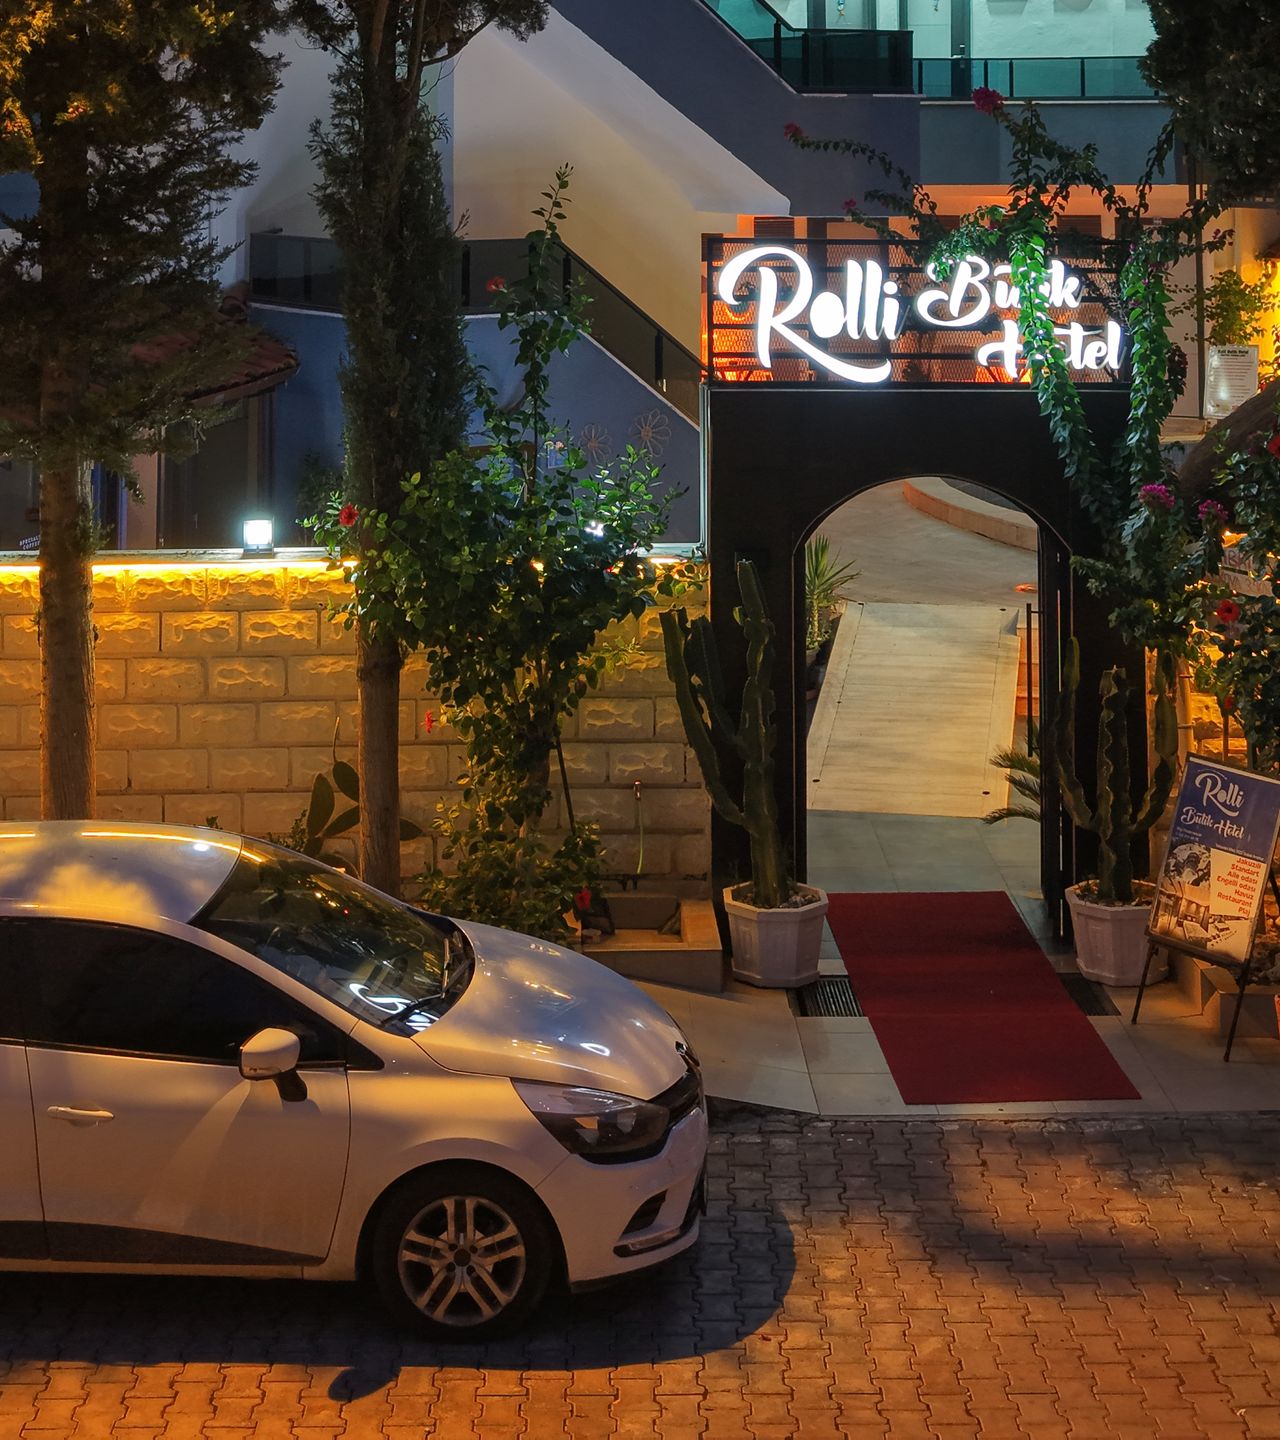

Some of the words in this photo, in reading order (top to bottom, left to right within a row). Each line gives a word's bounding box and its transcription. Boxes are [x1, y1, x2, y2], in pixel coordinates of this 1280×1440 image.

[719, 246, 906, 383] Rolli
[917, 255, 1083, 326] Buk
[976, 320, 1125, 378] Htel
[1195, 772, 1245, 817] Rolli
[1181, 806, 1213, 827] Butik
[1214, 820, 1244, 839] Hotel
[1227, 870, 1239, 879] Aile
[1231, 863, 1259, 877] Standart
[1217, 875, 1238, 886] Engelli
[1217, 892, 1252, 908] Restaurant
[1234, 889, 1253, 900] Havuz
